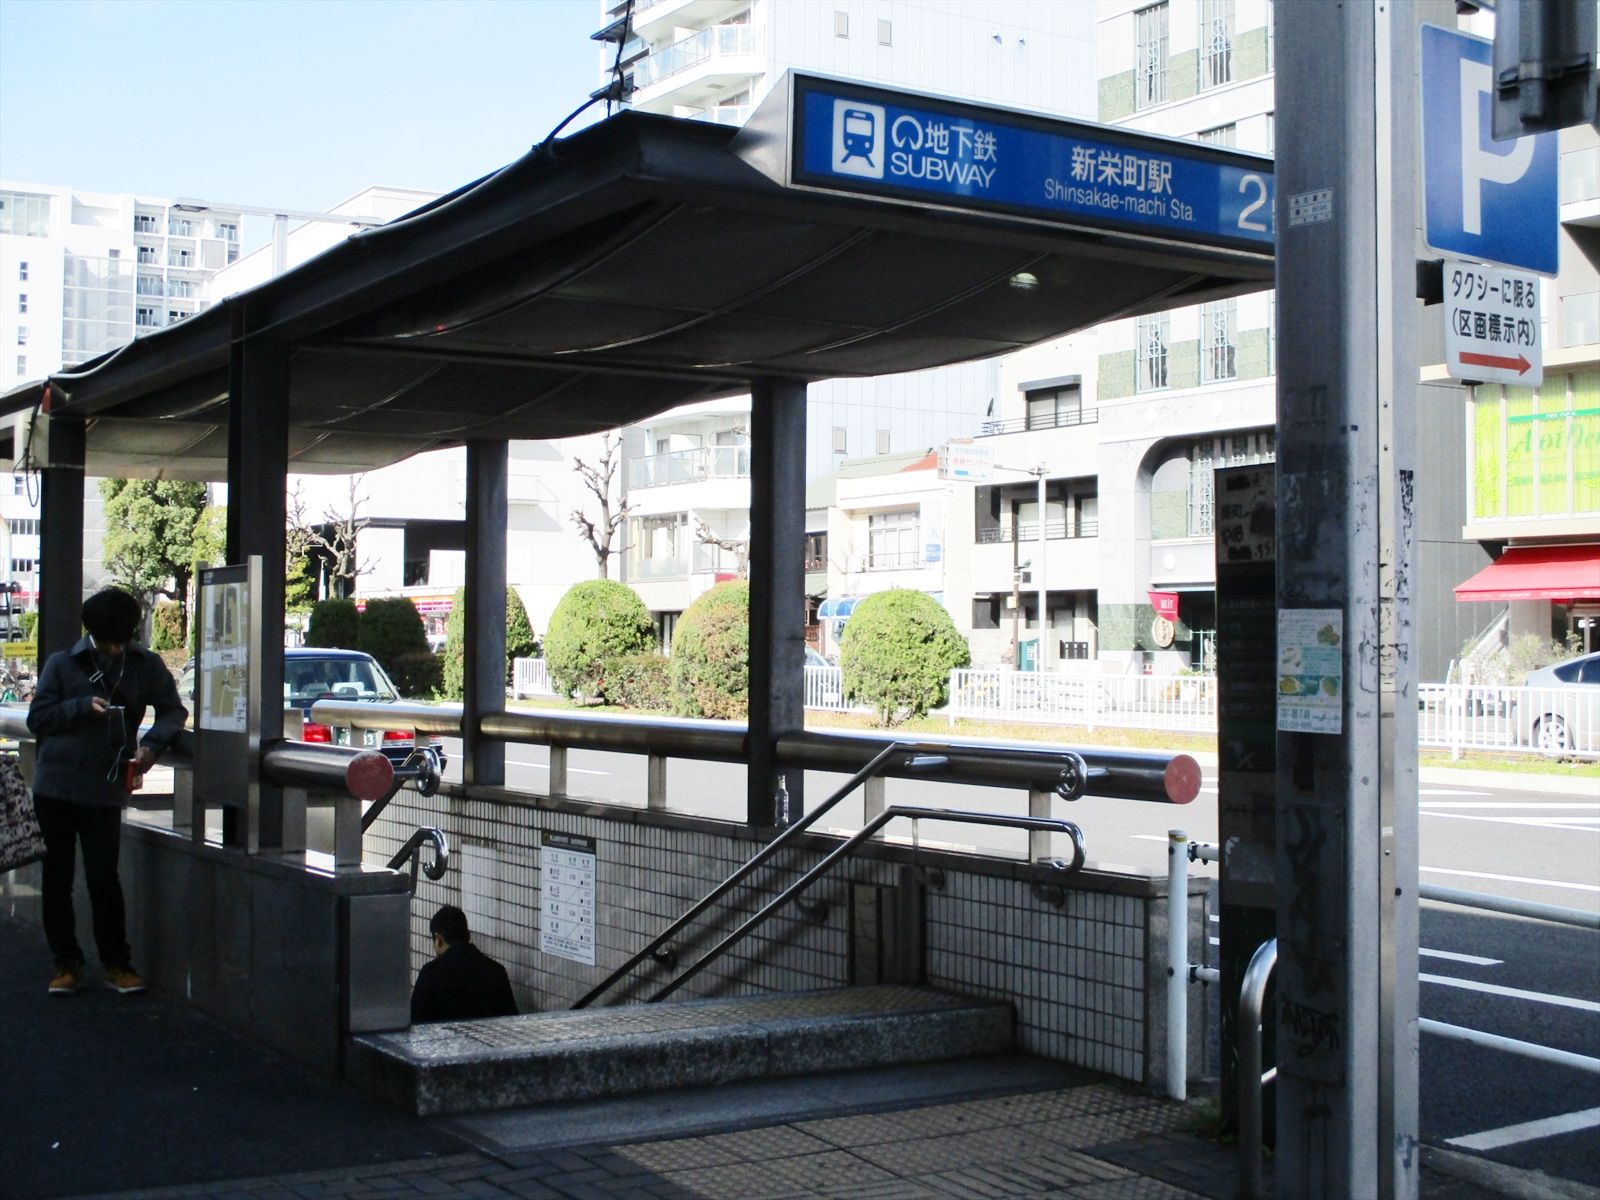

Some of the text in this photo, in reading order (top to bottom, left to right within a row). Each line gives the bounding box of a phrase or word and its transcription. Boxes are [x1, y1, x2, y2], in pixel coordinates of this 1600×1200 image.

[925, 120, 998, 163] 地下鉄
[1460, 58, 1536, 236] P
[890, 151, 996, 188] SUBWAY
[1071, 145, 1172, 195] 新栄町駅
[1044, 178, 1197, 222] Shinsakae-machi Sta.
[1237, 174, 1268, 232] 2
[1452, 270, 1536, 309] タクシーに限る
